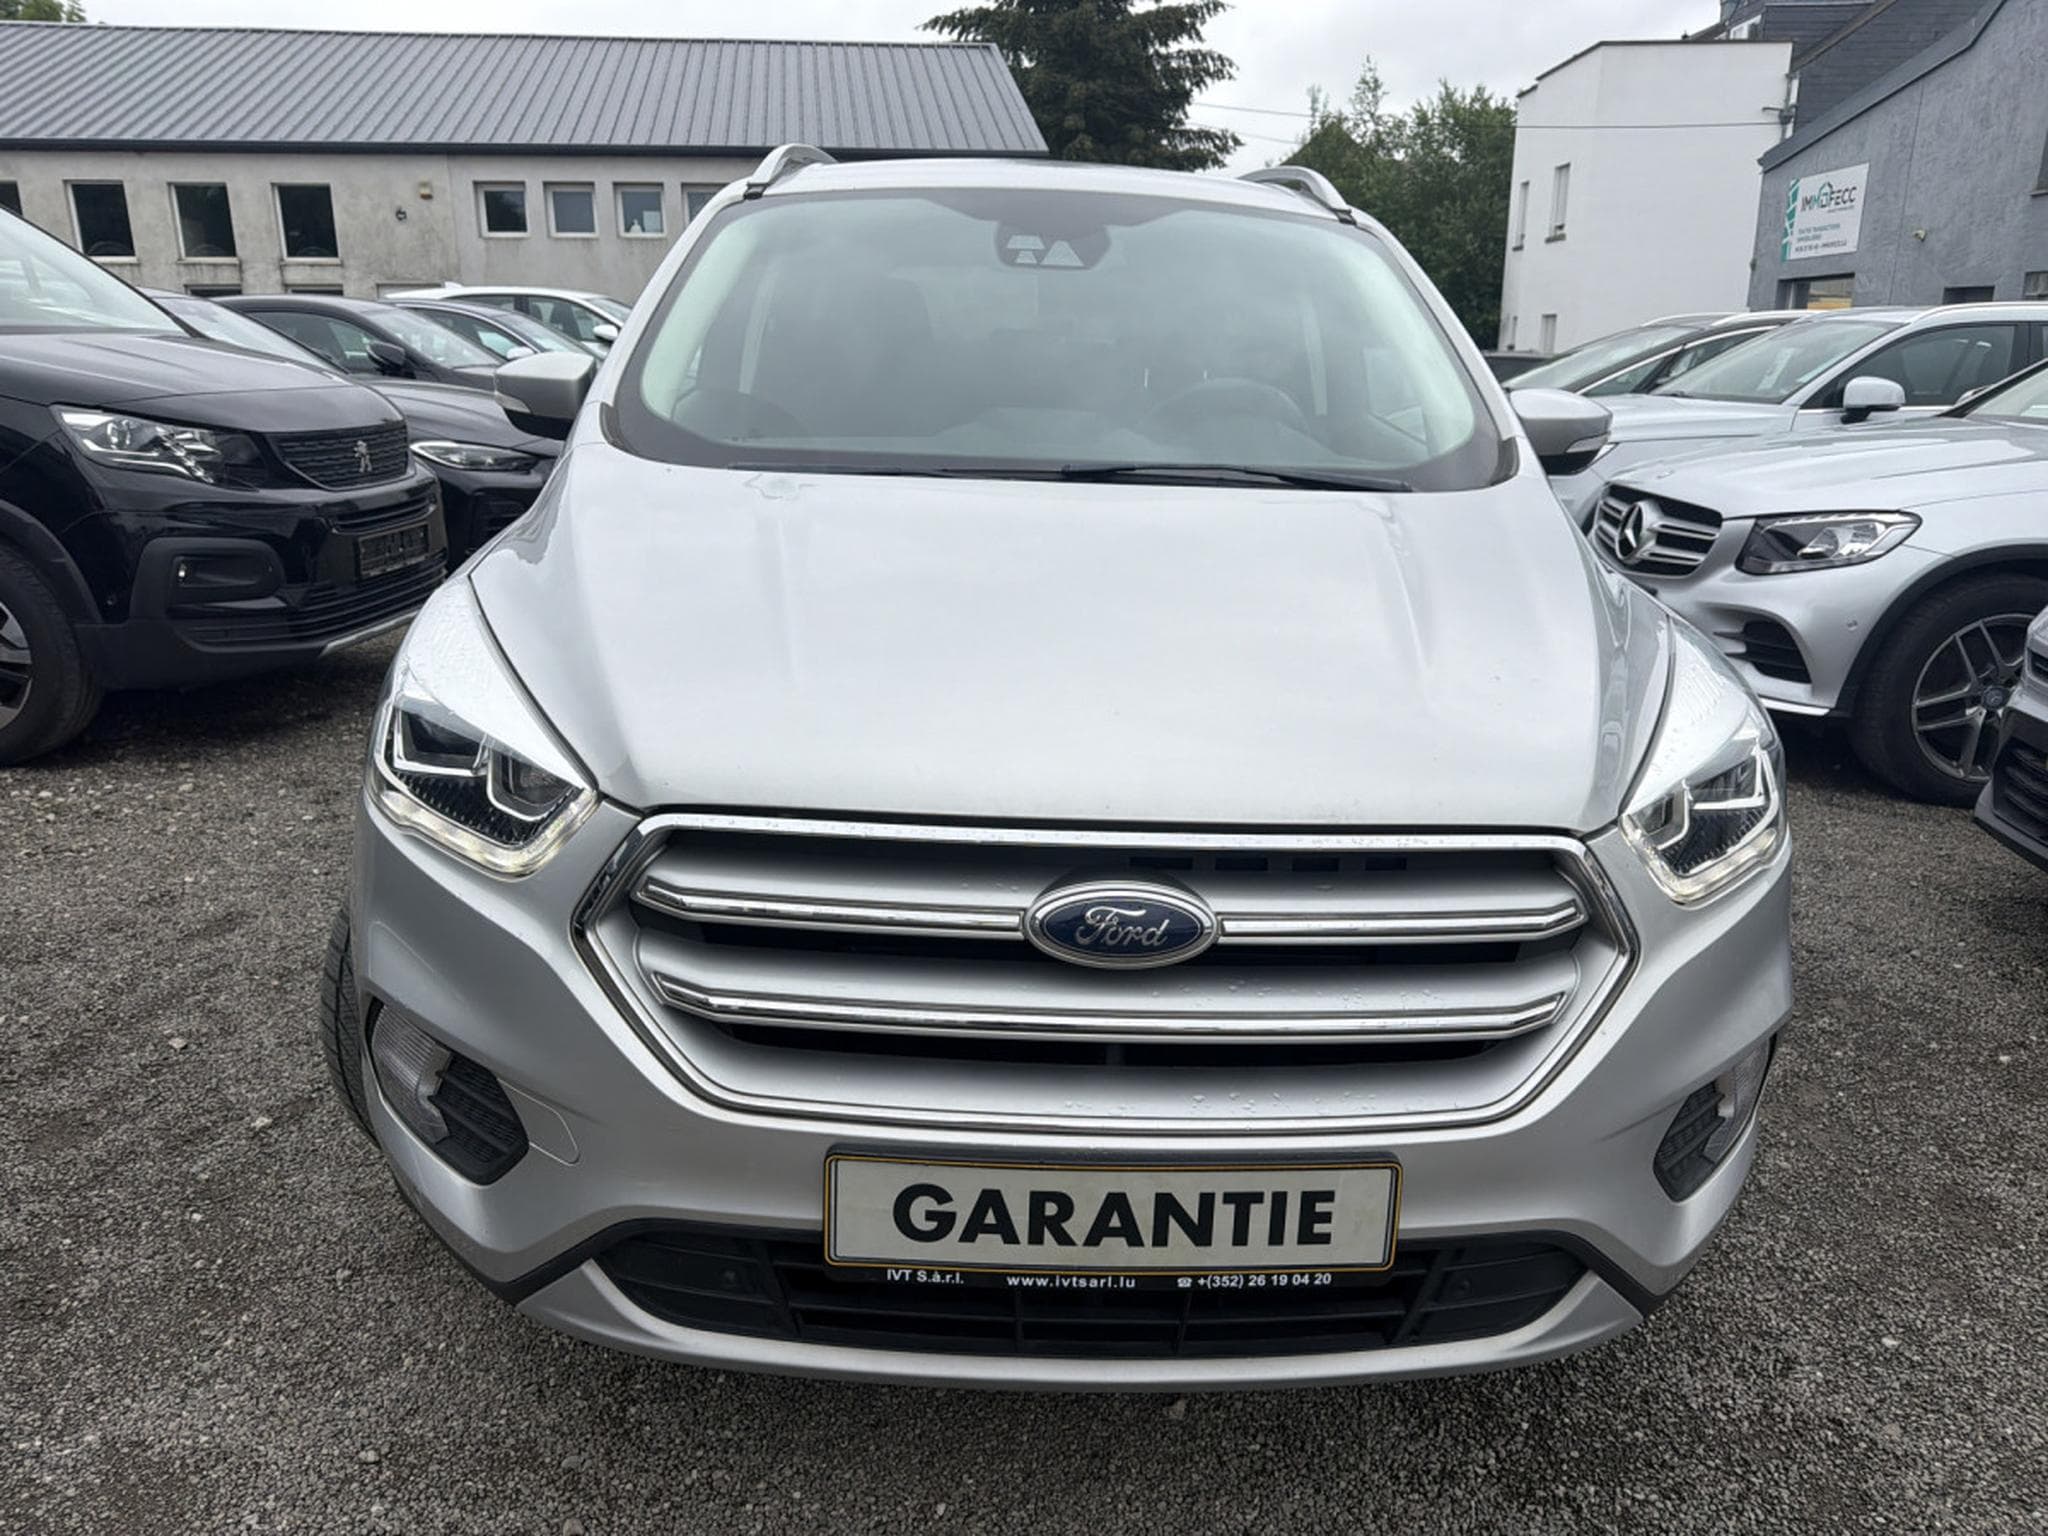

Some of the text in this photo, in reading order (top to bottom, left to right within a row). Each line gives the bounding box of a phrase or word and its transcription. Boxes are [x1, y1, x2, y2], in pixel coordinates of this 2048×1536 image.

[1075, 905, 1170, 947] Ford
[893, 1183, 1336, 1248] GARANTIE
[887, 1268, 913, 1282] IVT
[1007, 1275, 1136, 1288] www.ivtsarl.lu
[1197, 1274, 1244, 1289] +(352)
[1248, 1274, 1266, 1287] 26
[1271, 1274, 1288, 1286] 19
[1292, 1273, 1310, 1286] 04
[1313, 1272, 1332, 1285] 20
